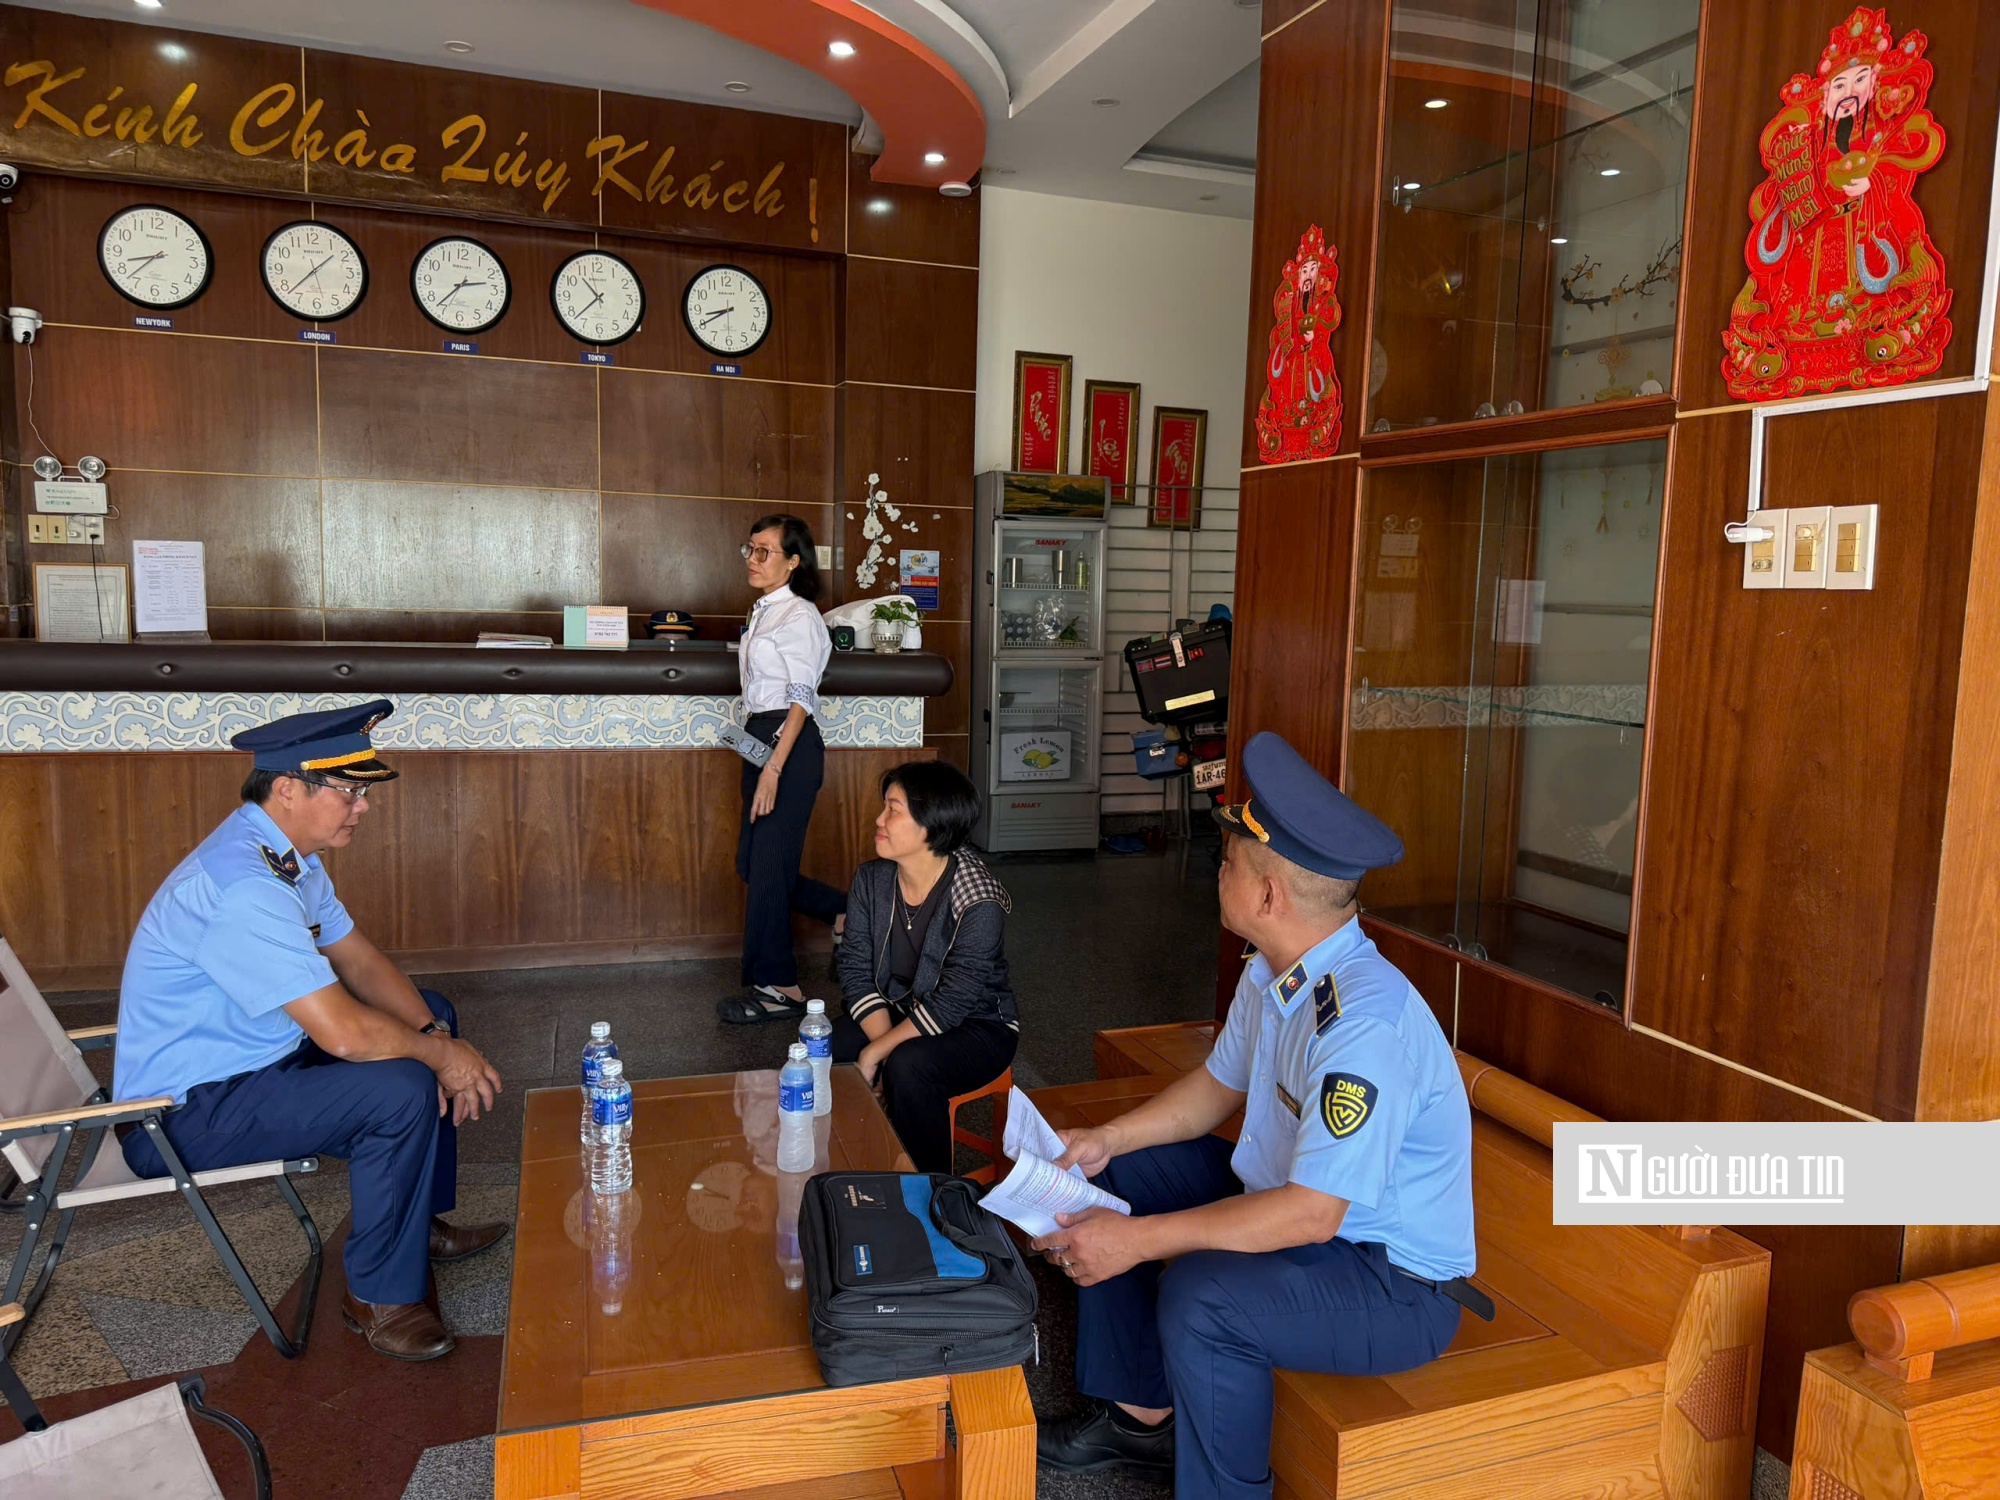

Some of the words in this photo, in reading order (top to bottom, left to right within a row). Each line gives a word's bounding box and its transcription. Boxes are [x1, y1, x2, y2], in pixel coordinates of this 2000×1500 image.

[5, 60, 203, 148] Kính
[586, 134, 785, 217] Khách
[1775, 129, 1809, 160] Chúc
[1776, 147, 1813, 183] Mừng
[1780, 174, 1813, 207] Năm
[1789, 196, 1819, 230] Mới
[134, 219, 143, 231] 11
[151, 217, 164, 230] 12
[119, 229, 131, 241] 10
[307, 233, 319, 244] 12
[186, 239, 194, 251] 2
[291, 236, 300, 248] 11
[113, 245, 122, 257] 9
[278, 247, 290, 258] 10
[341, 251, 349, 262] 2
[443, 250, 450, 262] 11
[457, 249, 469, 260] 12
[118, 263, 126, 274] 8
[189, 257, 198, 269] 3
[430, 260, 440, 271] 10
[592, 262, 603, 273] 12
[274, 263, 283, 275] 9
[346, 267, 354, 279] 3
[488, 268, 495, 279] 2
[578, 265, 586, 276] 11
[132, 277, 141, 288] 7
[184, 273, 192, 285] 4
[424, 275, 432, 285] 9
[567, 275, 577, 286] 10
[622, 279, 629, 289] 2
[721, 276, 731, 286] 12
[150, 285, 159, 296] 6
[170, 283, 179, 294] 5
[281, 280, 289, 291] 8
[343, 284, 350, 295] 4
[490, 285, 498, 296] 3
[708, 280, 715, 290] 11
[295, 293, 303, 304] 7
[331, 295, 339, 306] 5
[427, 291, 435, 302] 8
[563, 291, 570, 301] 9
[626, 295, 633, 305] 3
[698, 290, 707, 300] 10
[749, 292, 756, 302] 2
[313, 298, 321, 309] 6
[485, 300, 492, 310] 4
[439, 304, 447, 315] 7
[473, 309, 481, 320] 5
[568, 306, 575, 316] 8
[622, 310, 629, 320] 4
[694, 304, 701, 315] 9
[753, 307, 760, 318] 3
[136, 317, 171, 327] NEWYORK
[456, 311, 463, 322] 6
[581, 318, 587, 328] 7
[612, 320, 619, 331] 5
[699, 319, 706, 330] 8
[750, 322, 757, 332] 4
[596, 324, 603, 334] 6
[304, 332, 330, 340] LONDON
[711, 331, 717, 341] 7
[725, 336, 732, 346] 6
[741, 332, 748, 343] 5
[451, 343, 470, 351] PARIS
[588, 354, 605, 362] TOKYO
[1013, 738, 1037, 754] Fresh
[1040, 737, 1064, 753] Lemon
[1336, 1079, 1366, 1098] DMS
[613, 1103, 629, 1113] Villy
